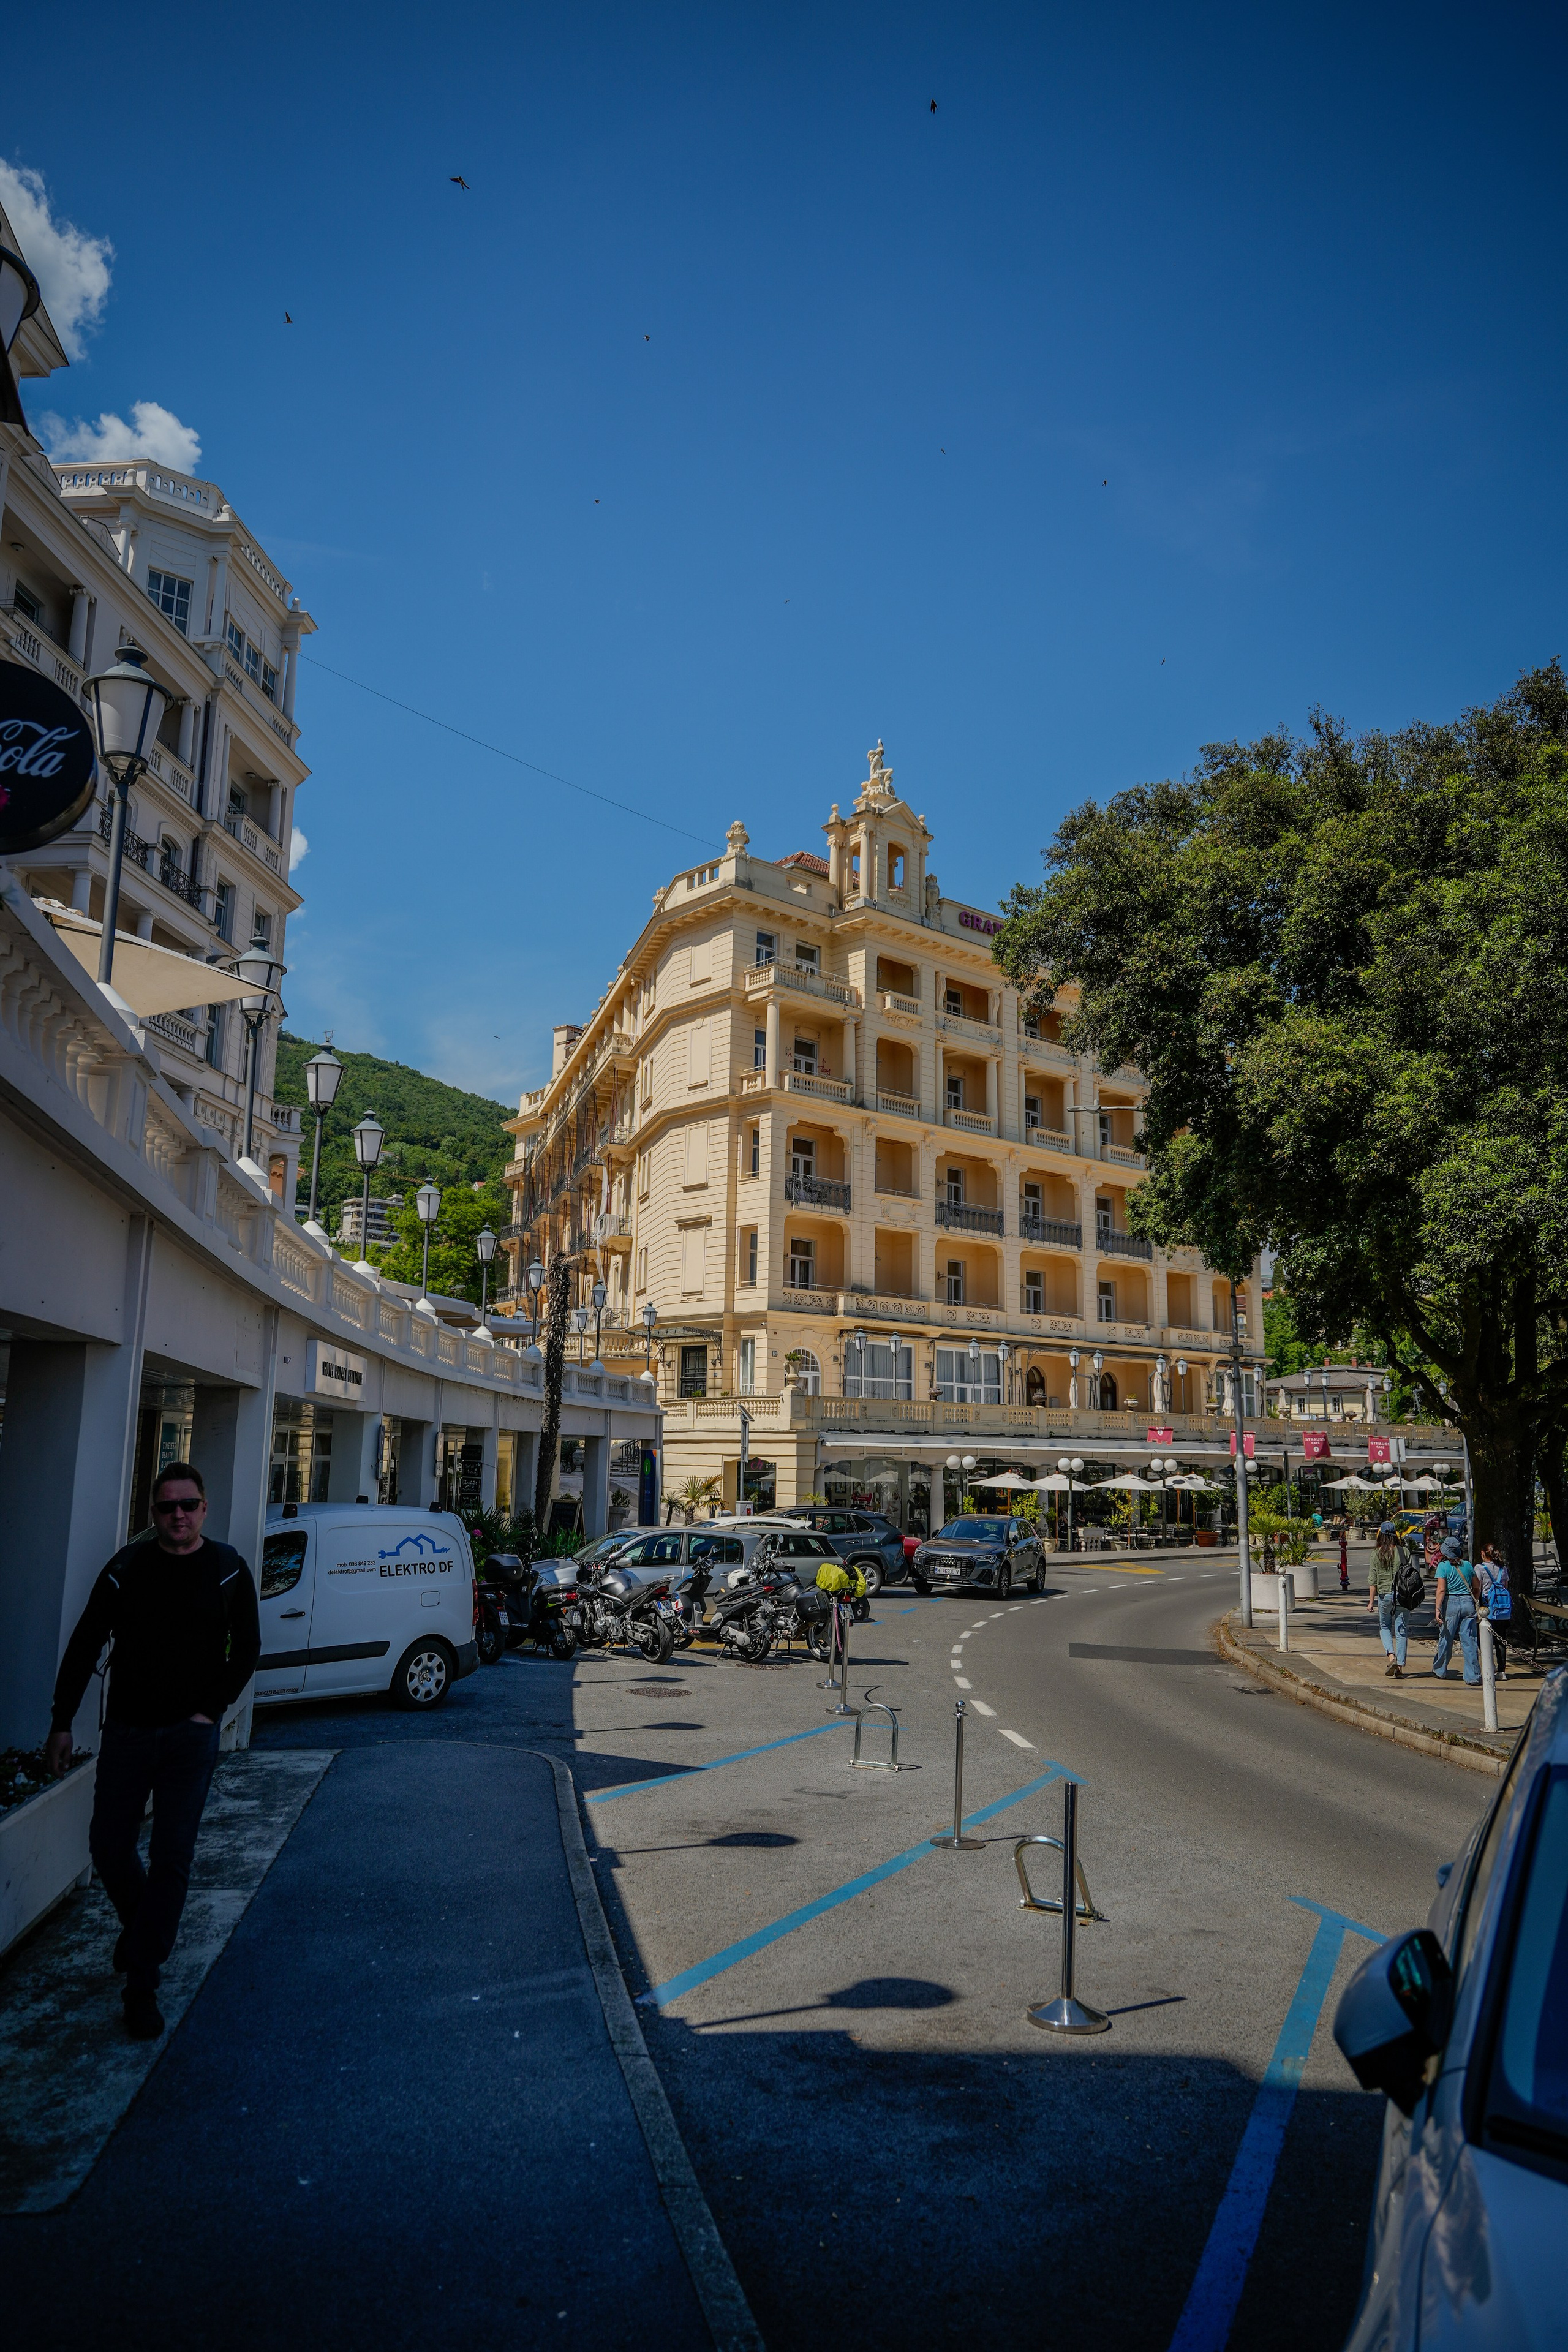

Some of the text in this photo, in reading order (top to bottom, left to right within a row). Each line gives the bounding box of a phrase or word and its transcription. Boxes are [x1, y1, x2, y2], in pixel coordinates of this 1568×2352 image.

[322, 1361, 363, 1385] HOTEL PALACE BELLEVUE
[328, 1567, 376, 1575] delektrof@gmail.com
[380, 1561, 453, 1577] ELEKTRO DF
